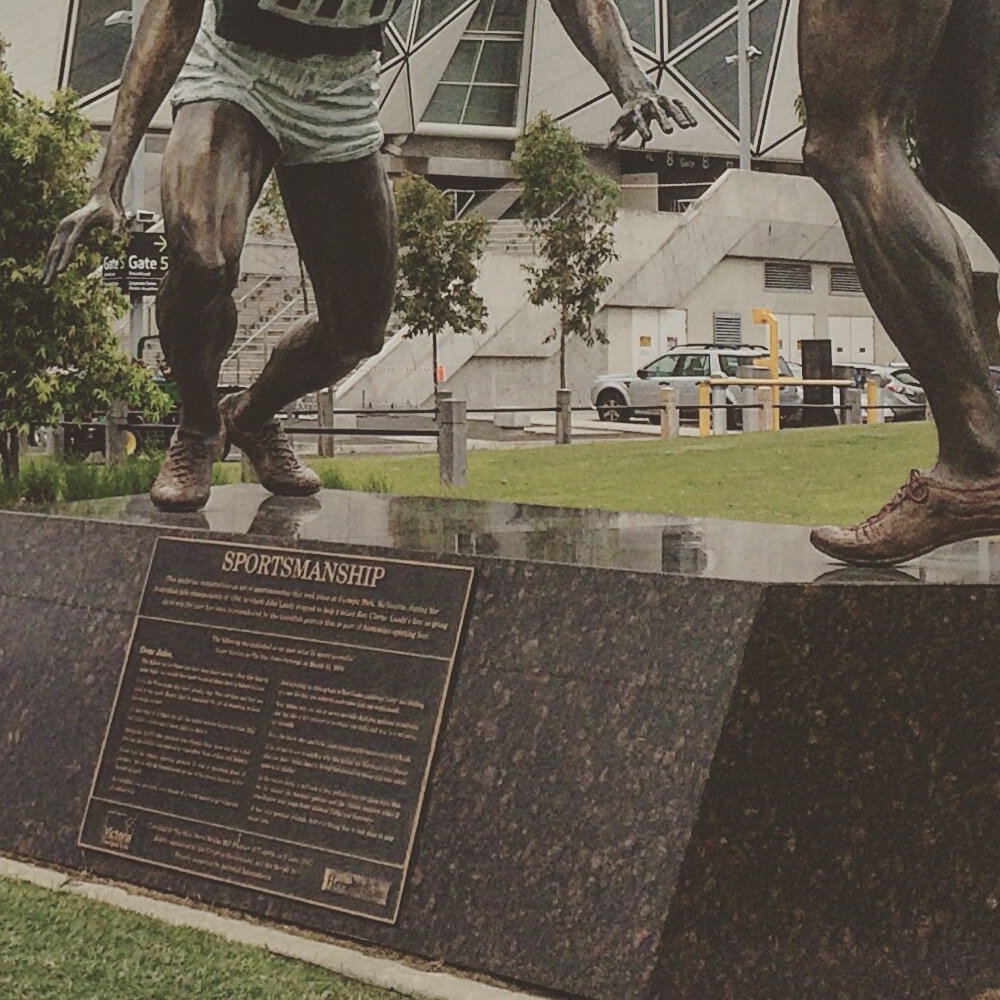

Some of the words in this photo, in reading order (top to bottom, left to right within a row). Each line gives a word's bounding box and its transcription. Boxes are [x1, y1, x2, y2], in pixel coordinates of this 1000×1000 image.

[128, 254, 158, 270] Gate
[159, 255, 169, 271] 5
[221, 550, 386, 588] SPORTSMANSHIP
